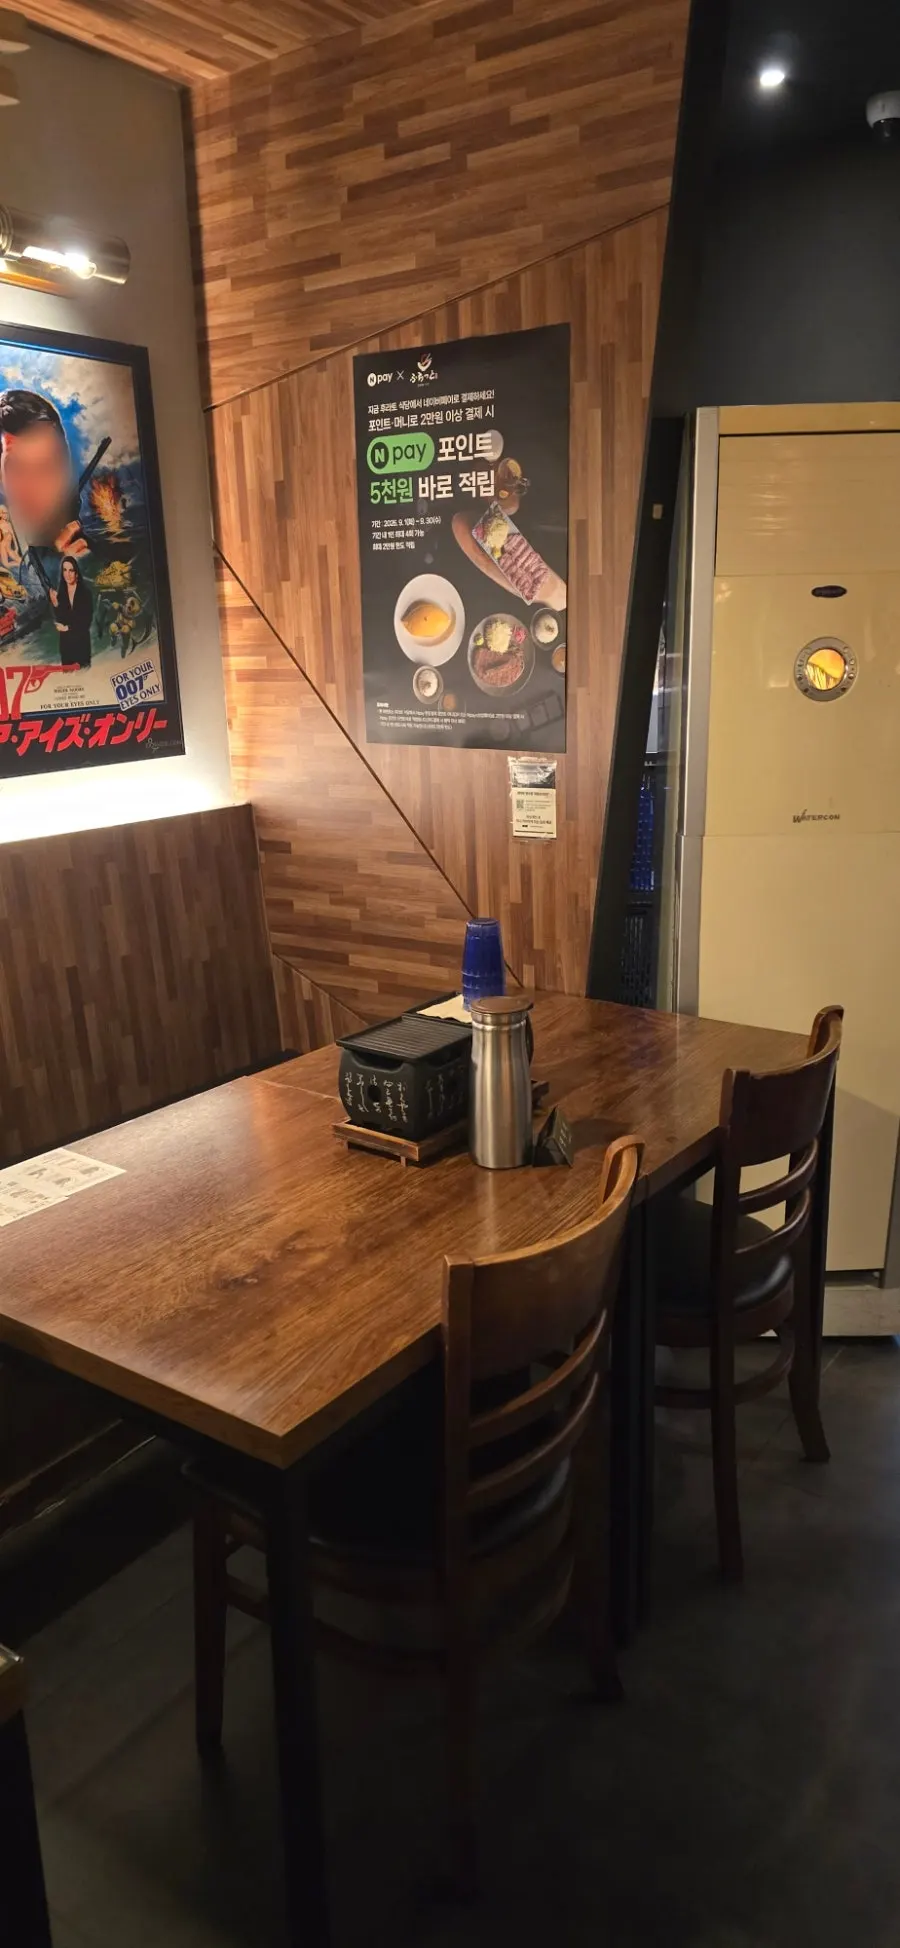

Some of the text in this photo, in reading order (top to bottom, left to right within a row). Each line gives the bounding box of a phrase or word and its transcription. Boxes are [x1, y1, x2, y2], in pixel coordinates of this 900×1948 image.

[368, 389, 495, 415] 지금 후라토 식당에서 네이버페이로 결제하세요!
[420, 411, 444, 426] 2만원
[446, 408, 464, 422] 이상
[465, 406, 483, 420] 결제
[485, 404, 495, 418] 시
[437, 433, 494, 462] 포인트
[370, 470, 495, 504] 5천원 바로 적립
[112, 661, 153, 687] FOR YOUR
[115, 675, 144, 700] 007
[121, 683, 160, 710] EYES ONLY
[40, 702, 52, 710] FOR
[792, 809, 840, 823] WATERCON
